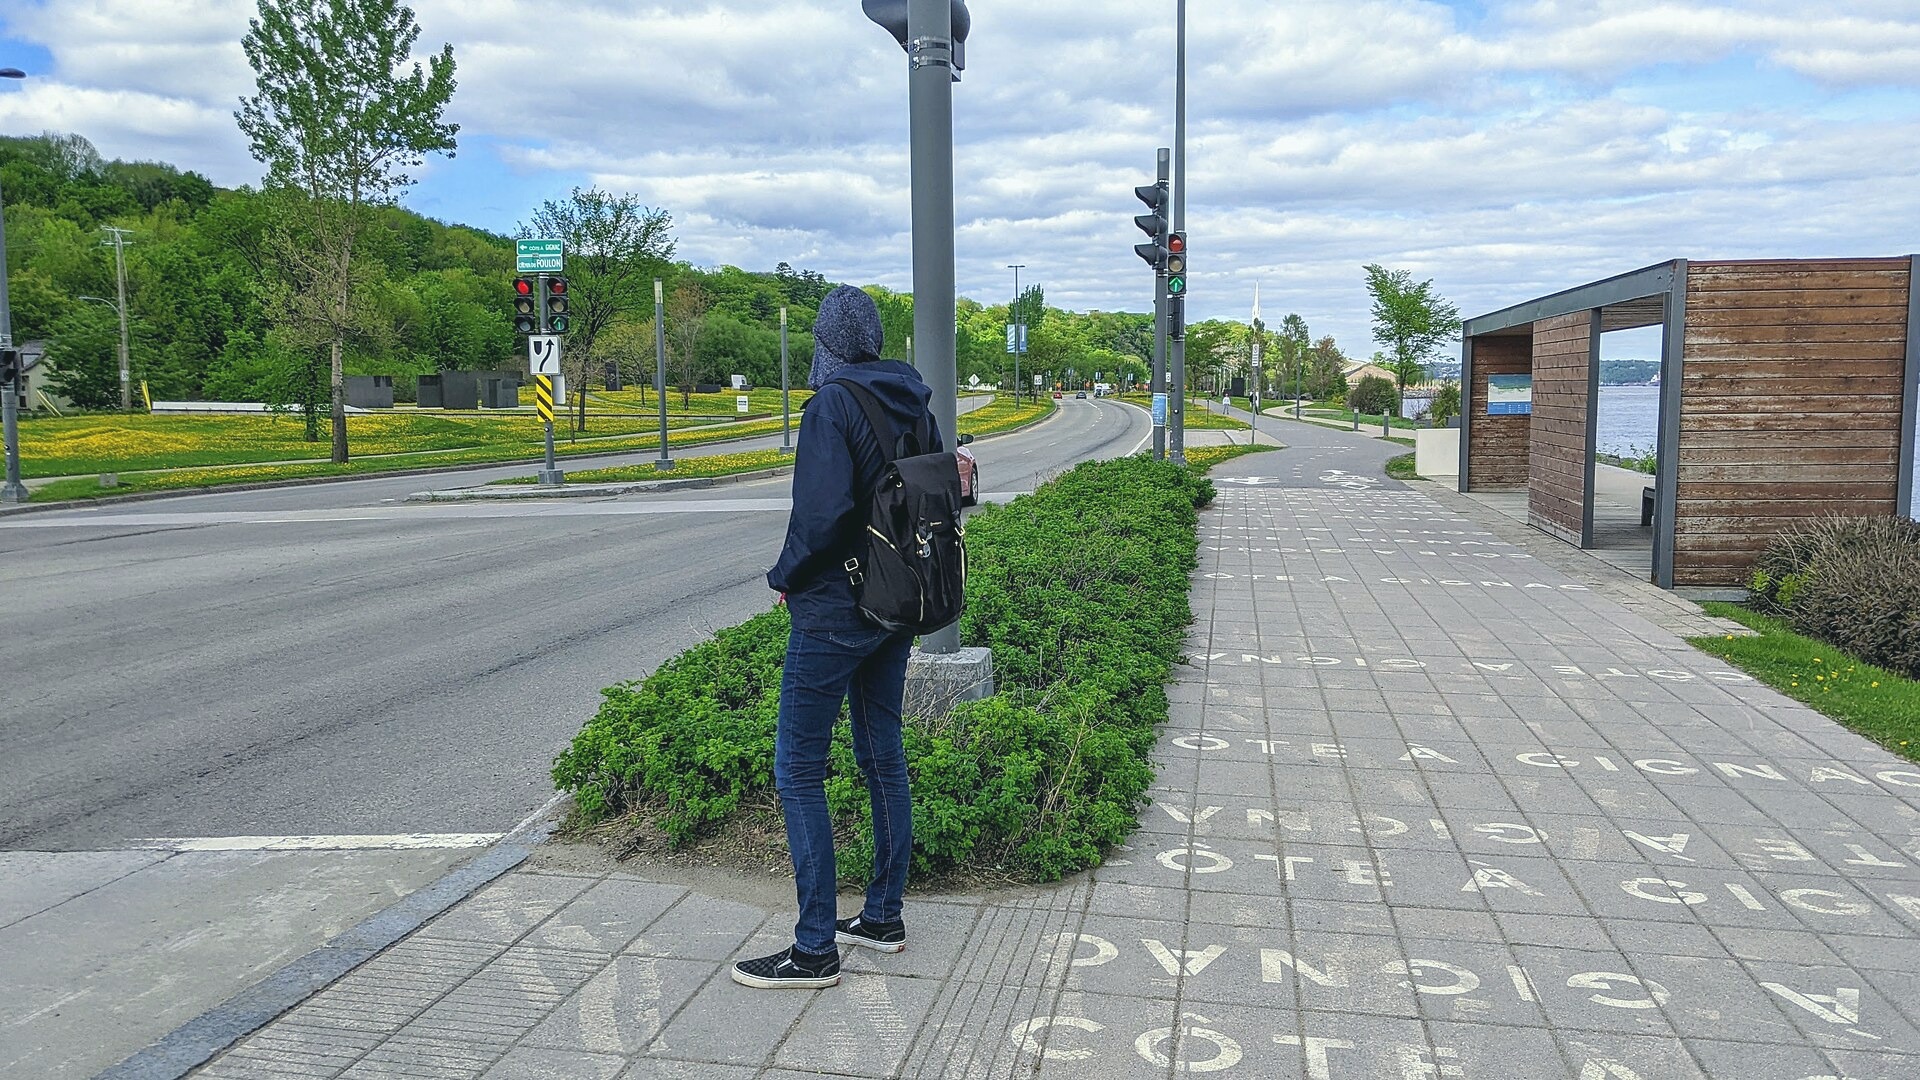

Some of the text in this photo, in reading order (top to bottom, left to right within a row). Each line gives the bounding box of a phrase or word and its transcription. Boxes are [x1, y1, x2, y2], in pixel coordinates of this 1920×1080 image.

[537, 259, 560, 268] FOULON
[1192, 652, 1426, 668] GIGNA
[1172, 732, 1348, 759] ÔTE
[1156, 802, 1549, 844] GIGNA
